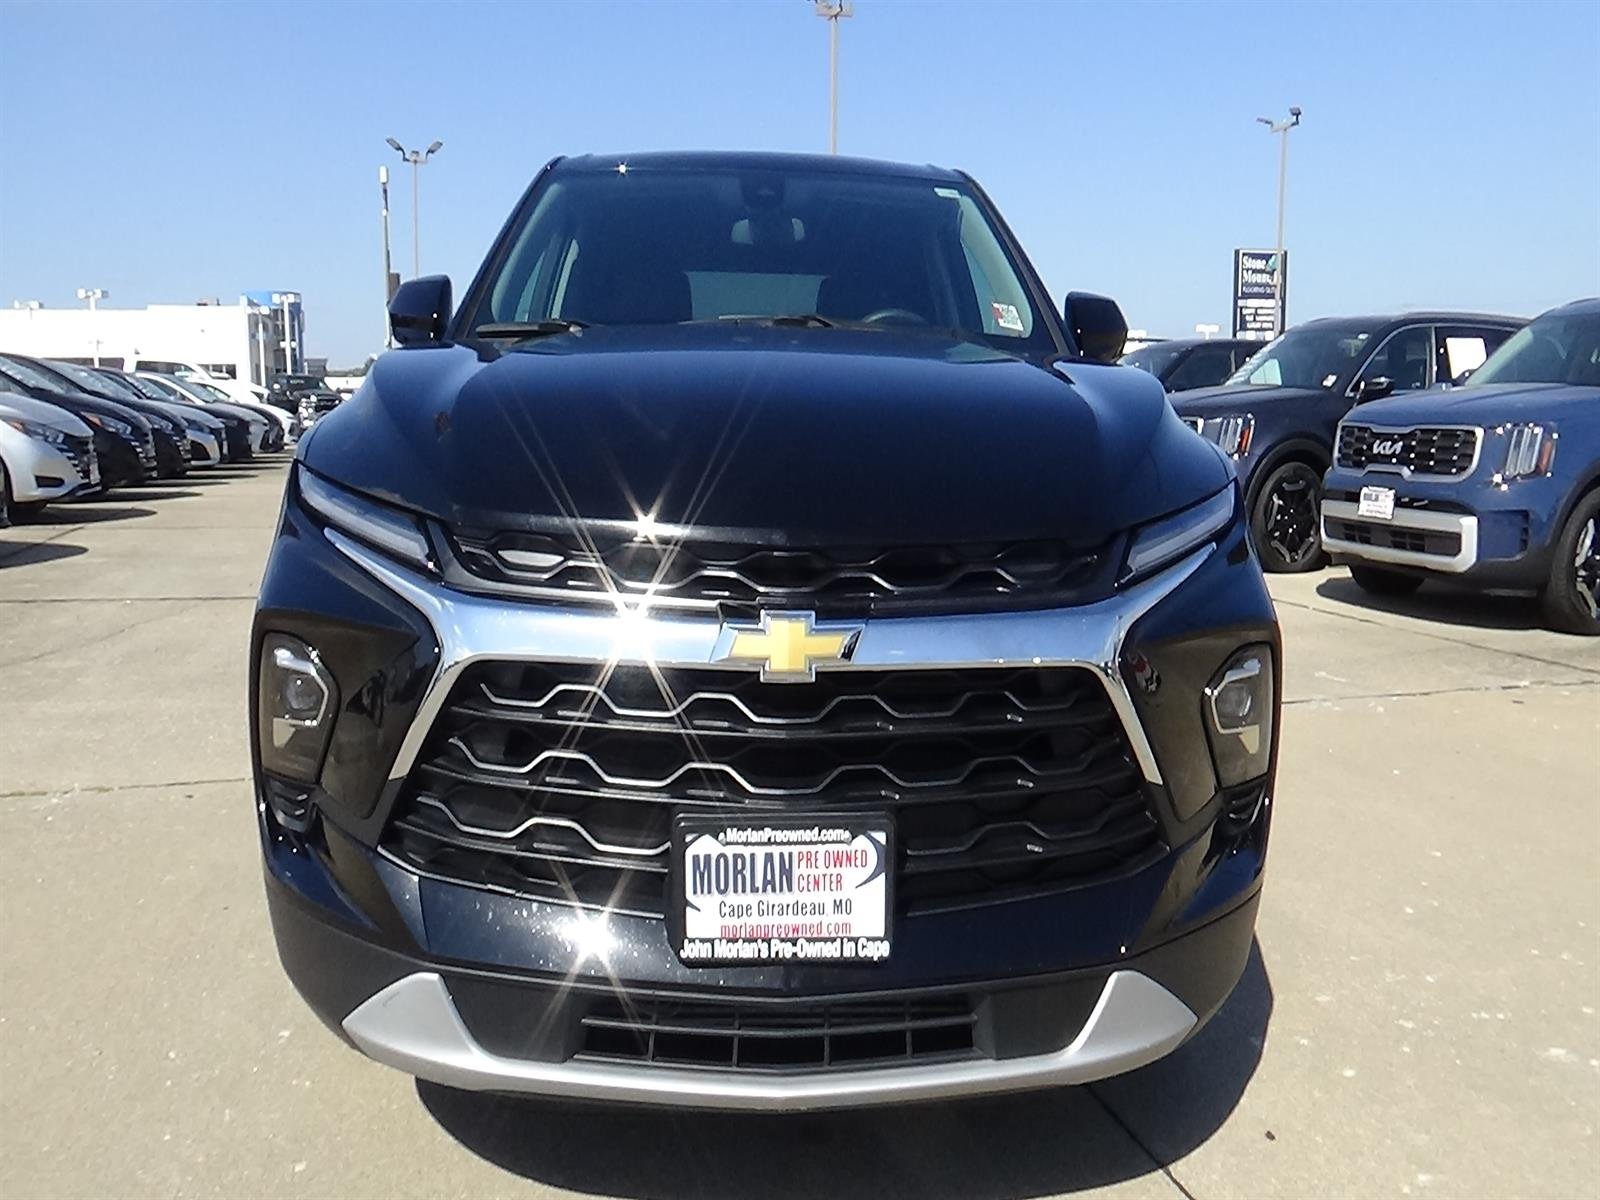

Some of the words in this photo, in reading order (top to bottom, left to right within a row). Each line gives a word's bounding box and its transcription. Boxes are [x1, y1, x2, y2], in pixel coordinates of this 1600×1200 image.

[726, 827, 847, 843] MorlanPreowned.com
[797, 851, 819, 869] PRE
[824, 849, 868, 869] OWNED
[692, 851, 794, 895] MORLAN
[797, 874, 843, 892] CENTER
[719, 901, 752, 919] Cape
[833, 898, 852, 915] MO
[680, 939, 712, 959] John
[714, 938, 769, 958] Morlan's
[771, 938, 840, 959] Pre-Owned
[843, 938, 855, 957] in
[857, 937, 890, 960] Cape
